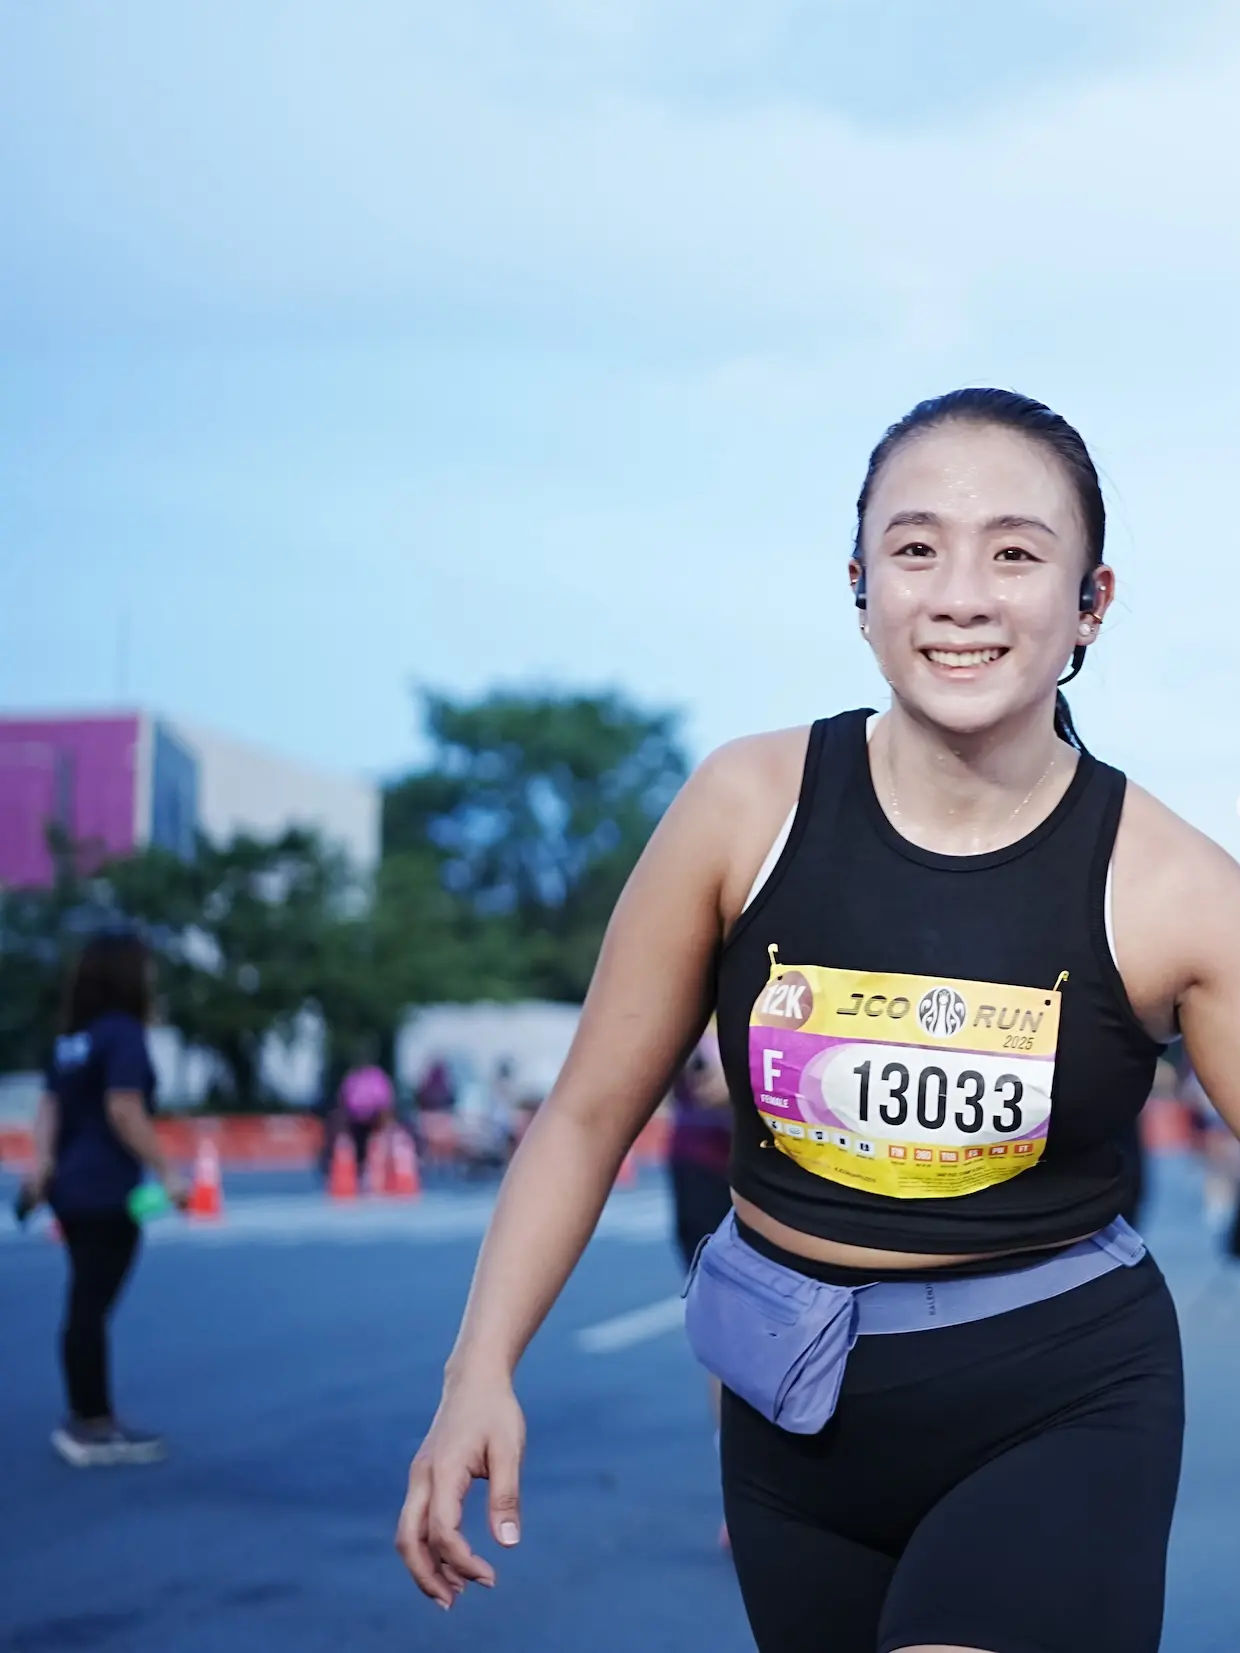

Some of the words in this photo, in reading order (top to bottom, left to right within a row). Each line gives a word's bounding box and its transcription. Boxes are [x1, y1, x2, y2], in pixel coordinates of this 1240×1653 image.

[761, 984, 806, 1019] 12K
[836, 993, 911, 1019] JCO
[972, 1004, 1044, 1033] RUN
[1002, 1035, 1034, 1051] 2025
[763, 1049, 784, 1092] F
[853, 1060, 1024, 1134] 13033
